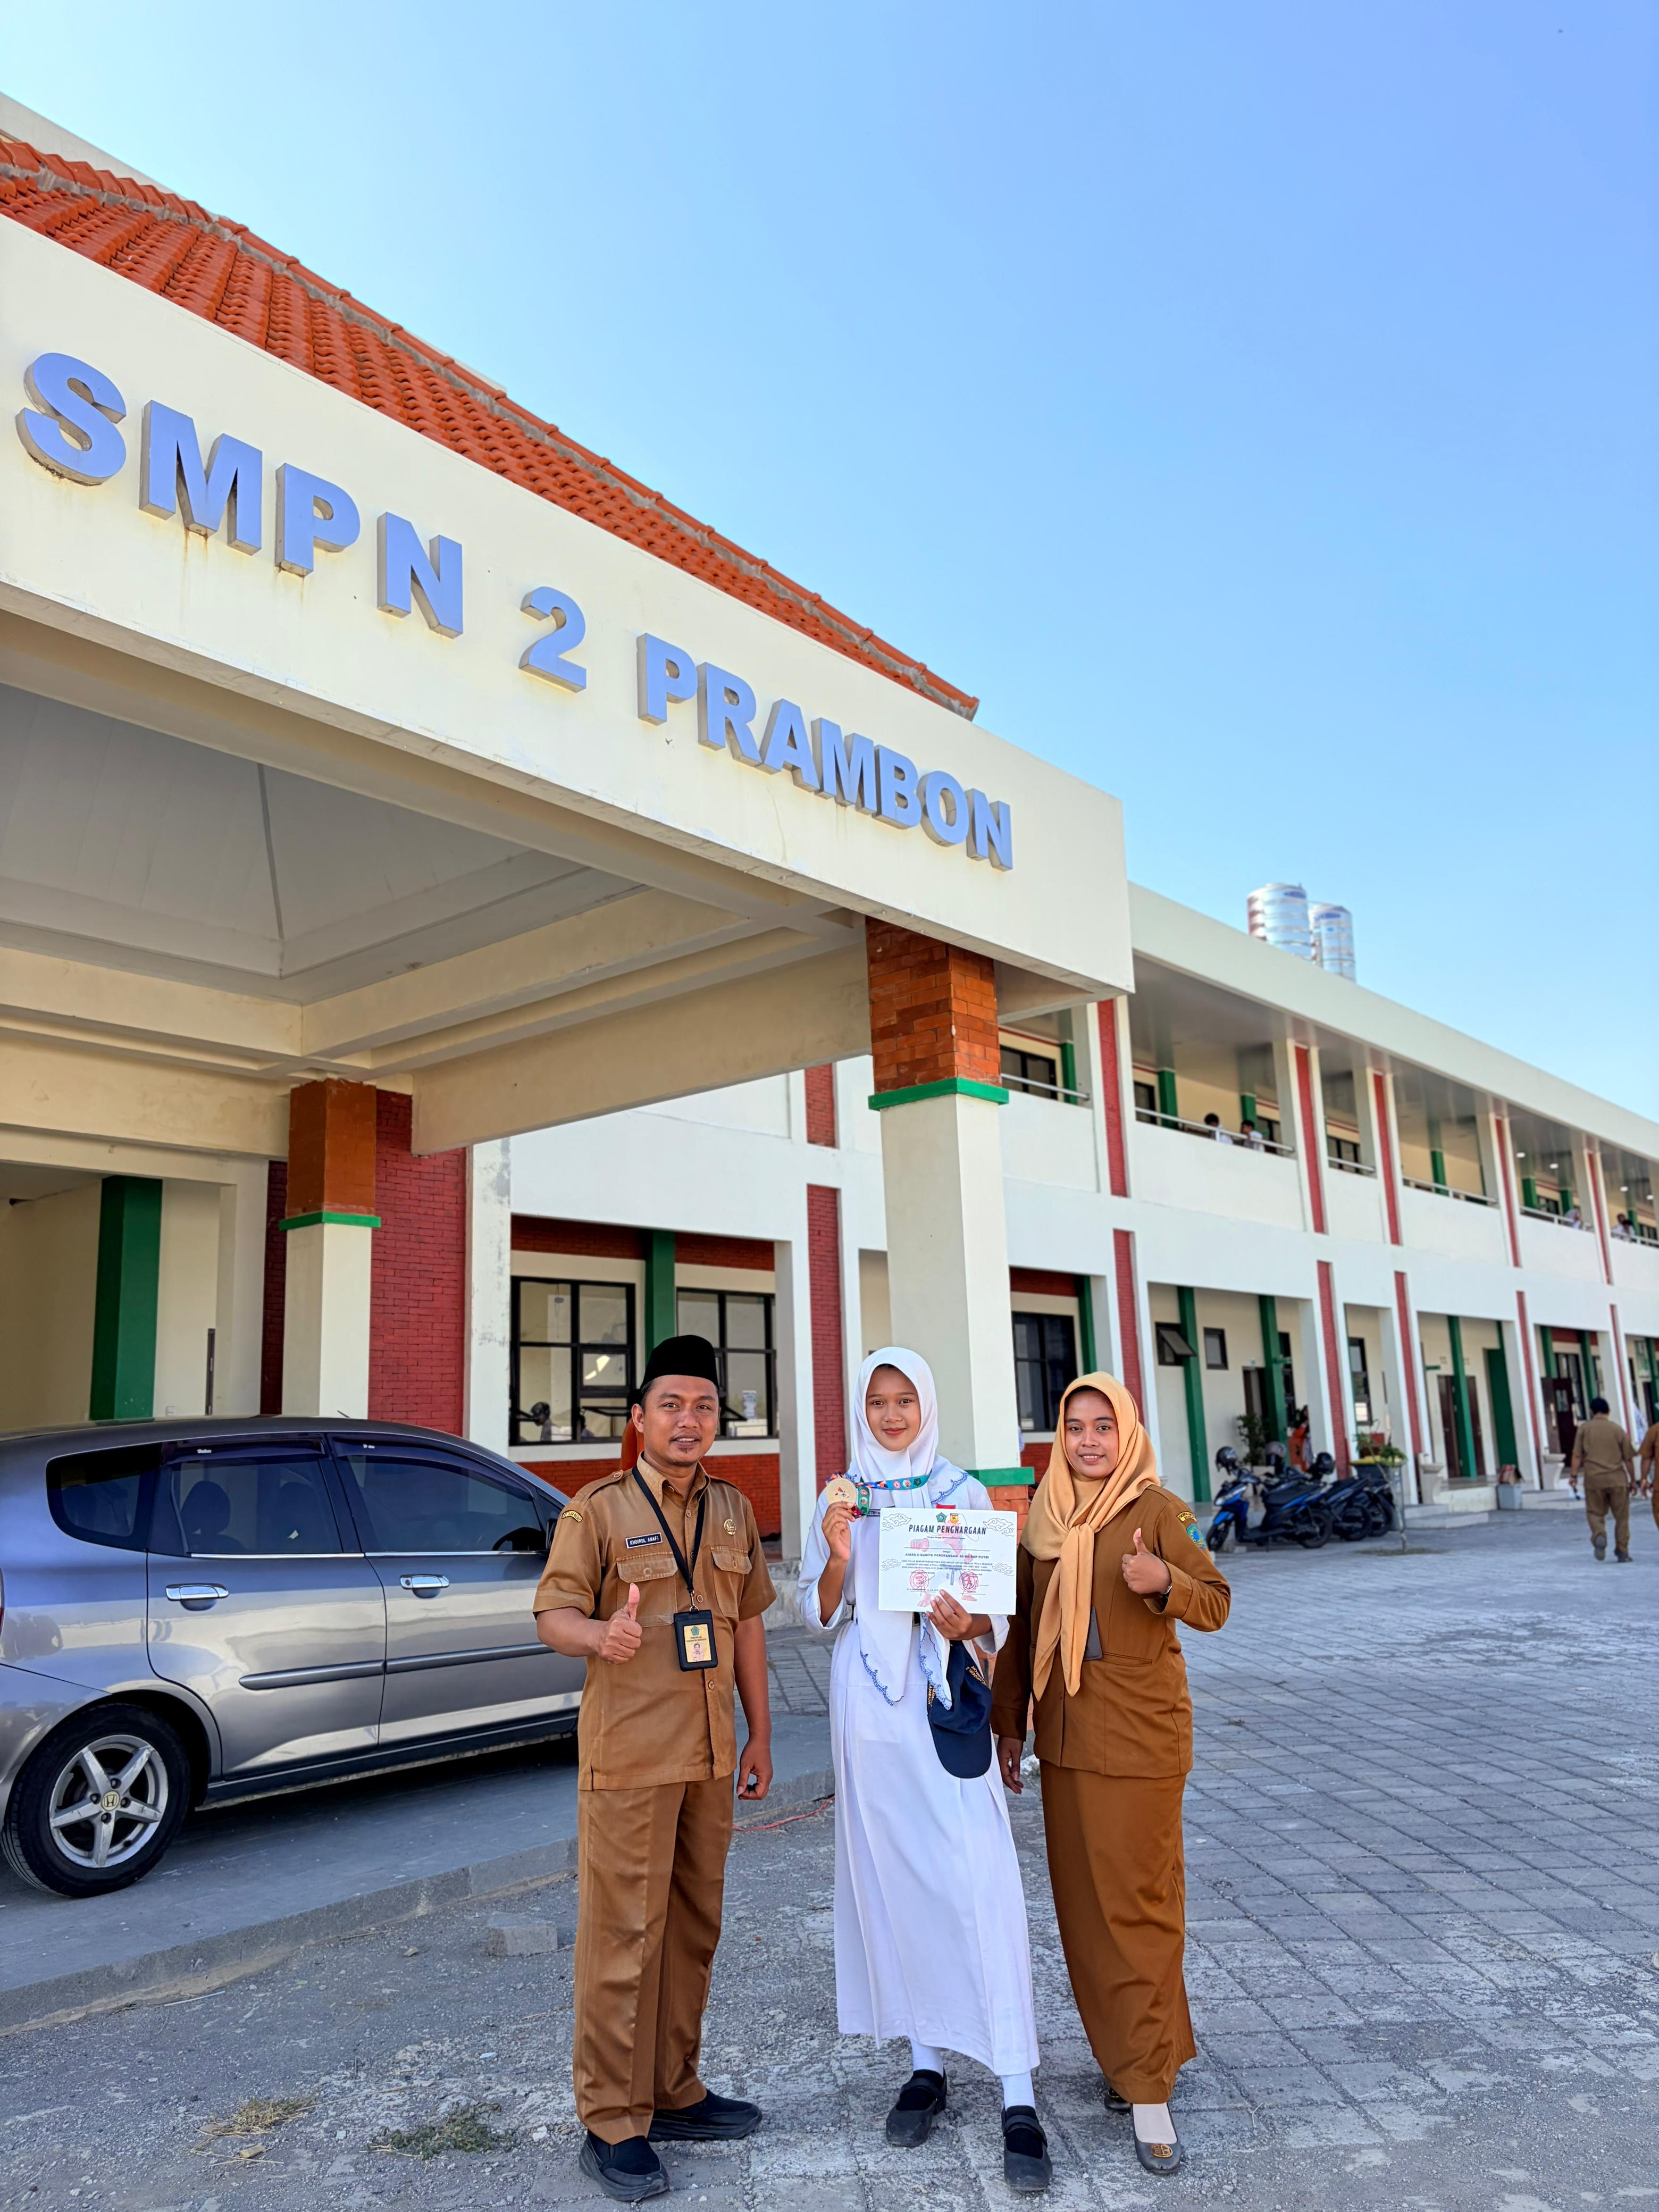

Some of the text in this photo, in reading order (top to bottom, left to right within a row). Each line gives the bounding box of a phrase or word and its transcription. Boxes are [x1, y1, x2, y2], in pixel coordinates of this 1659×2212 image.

[15, 353, 1013, 872] SMPN 2 PRAMBON
[936, 1525, 986, 1535] PENGHARGAAN
